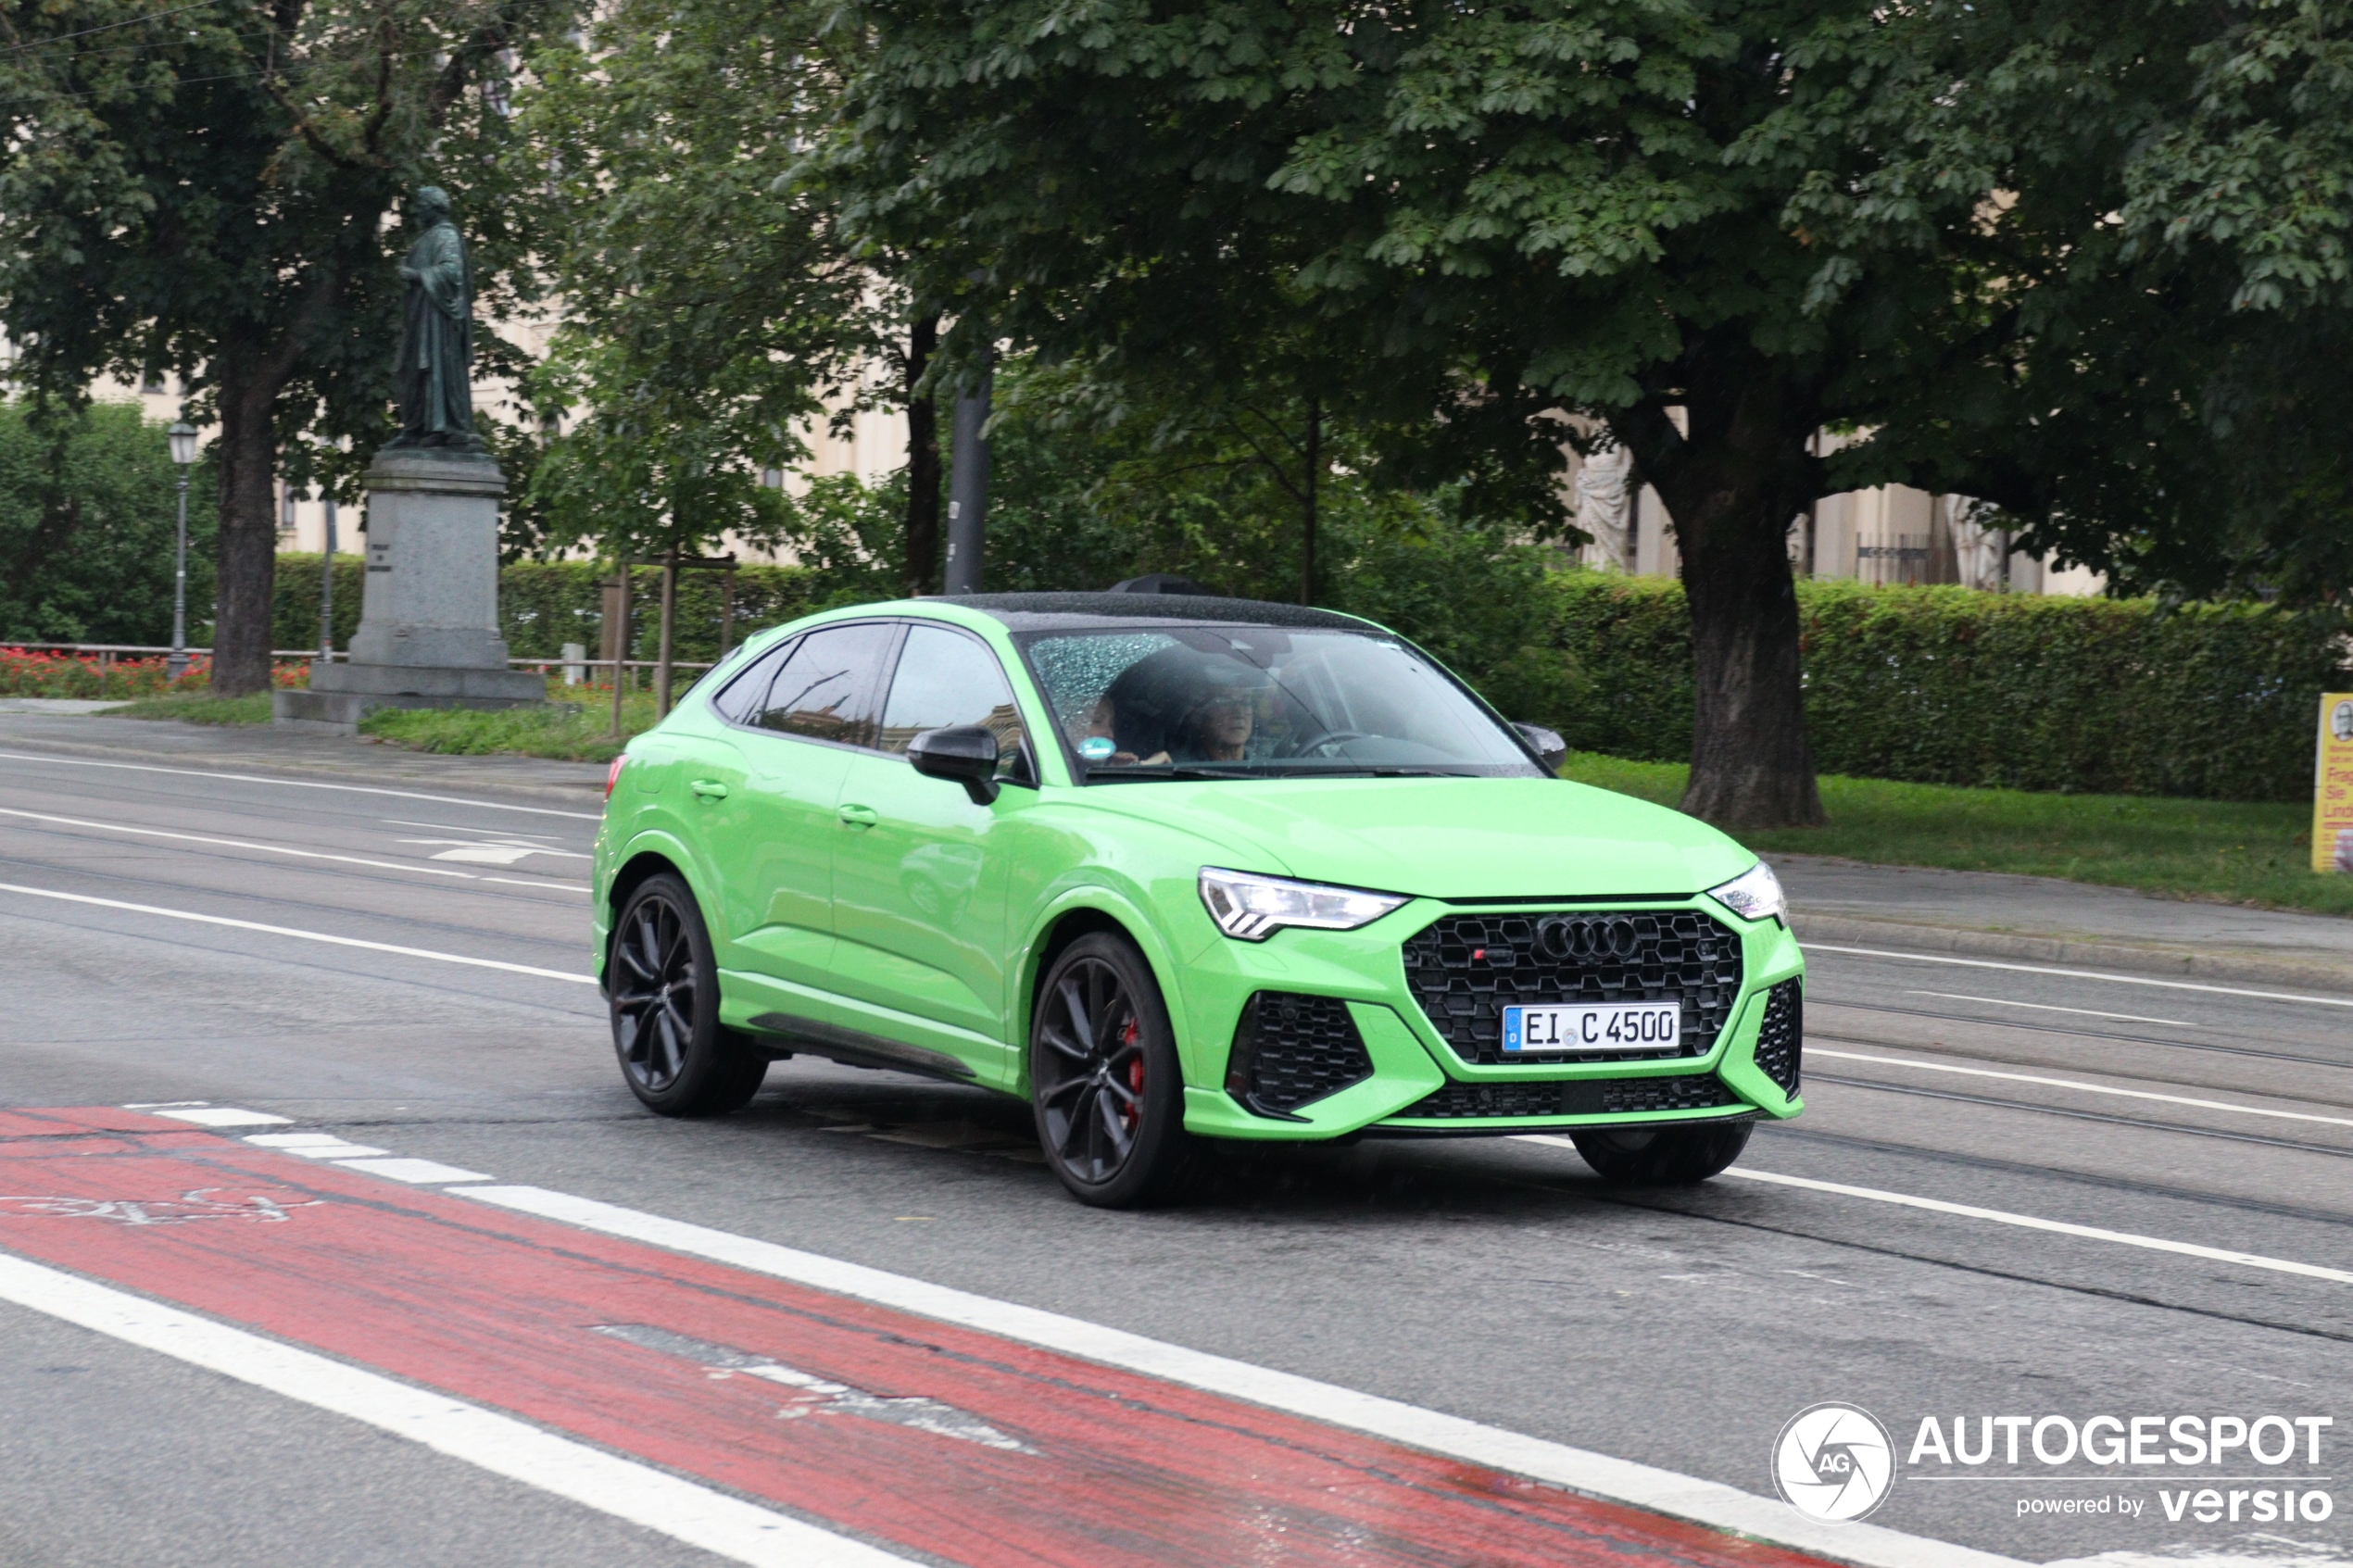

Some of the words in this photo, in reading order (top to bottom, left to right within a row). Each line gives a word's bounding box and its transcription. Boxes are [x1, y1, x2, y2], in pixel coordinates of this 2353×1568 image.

[2325, 784, 2346, 800] Sie
[1526, 1012, 1560, 1045] EI
[1582, 1012, 1598, 1043] C
[1606, 1010, 1673, 1043] 4500
[1509, 1033, 1516, 1043] D
